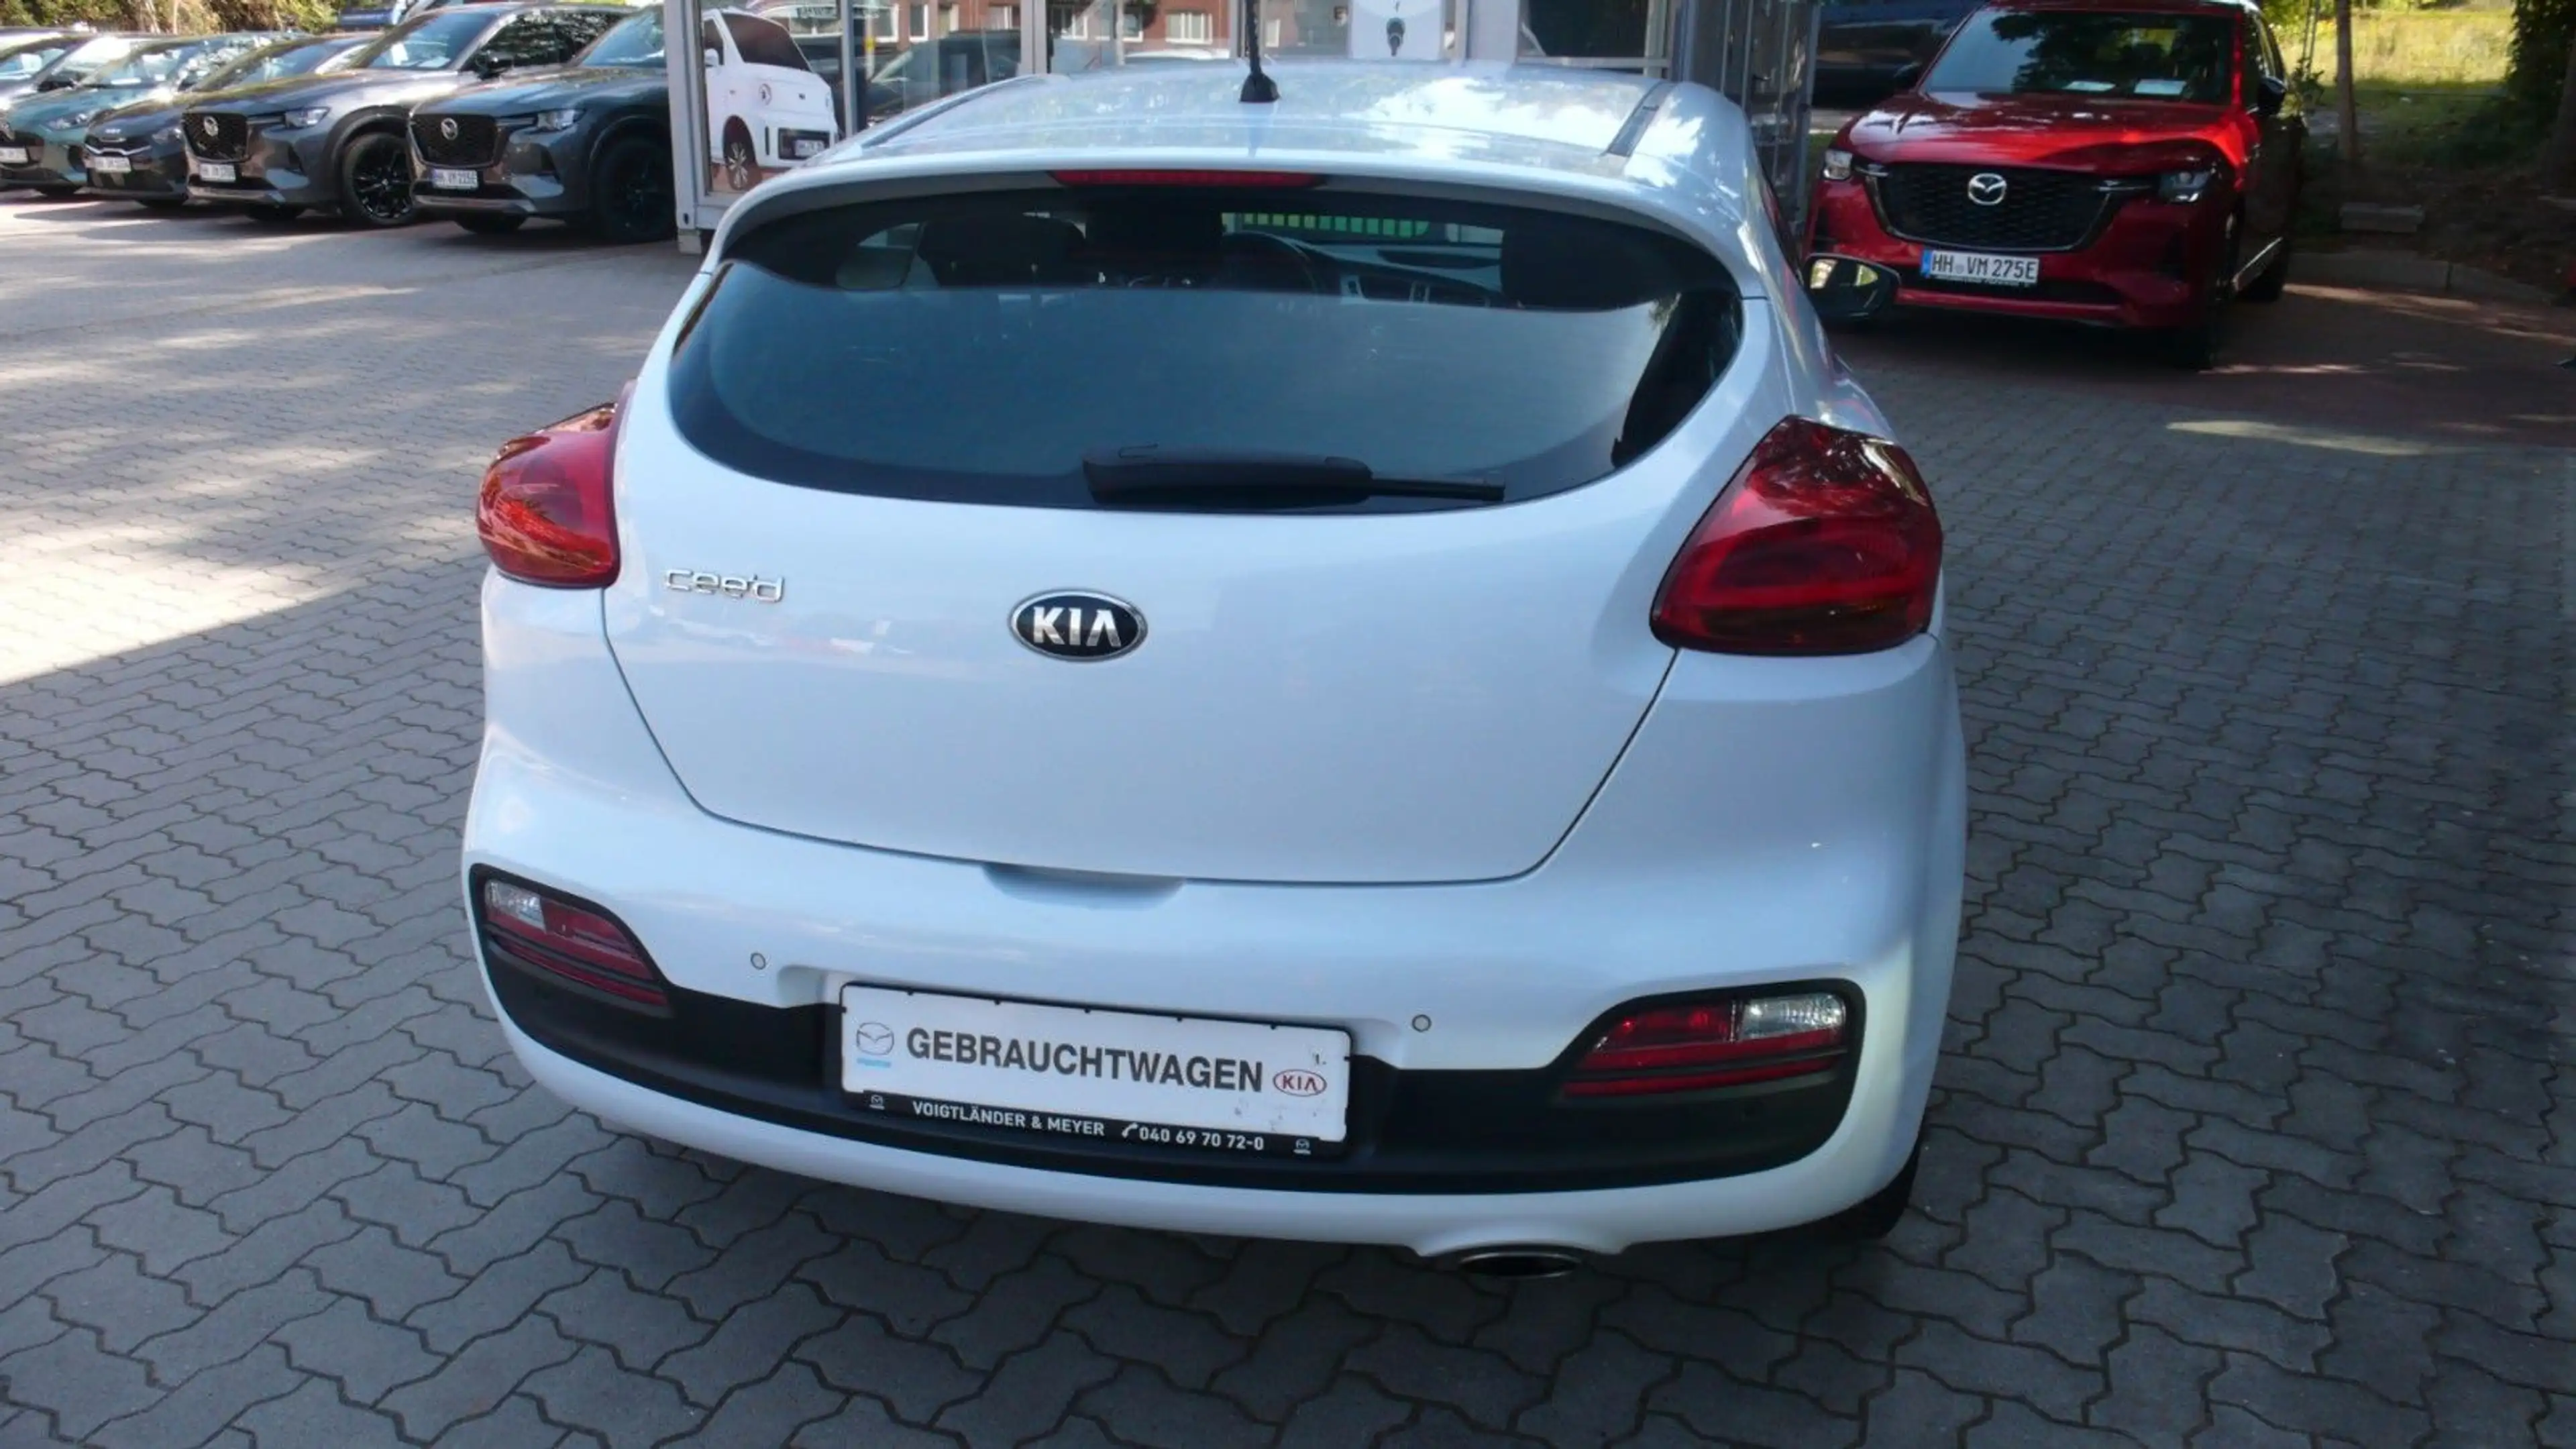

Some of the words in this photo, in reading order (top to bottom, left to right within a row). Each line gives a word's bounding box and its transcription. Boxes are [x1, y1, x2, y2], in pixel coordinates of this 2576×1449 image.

[1933, 252, 1954, 273] HH
[1967, 256, 1989, 276] VM
[1991, 259, 2037, 280] 275E
[1033, 606, 1122, 648] KIA
[907, 1027, 1263, 1093] GEBRAUCHTWAGEN
[1282, 1074, 1318, 1092] KIA
[912, 1100, 1026, 1128] VOIGTLÄNDER
[1031, 1115, 1043, 1130] &
[1047, 1116, 1106, 1136] MEYER
[1139, 1126, 1171, 1143] 040
[1175, 1129, 1197, 1145] 69
[1201, 1131, 1222, 1148] 70
[1226, 1134, 1265, 1151] 72-0
